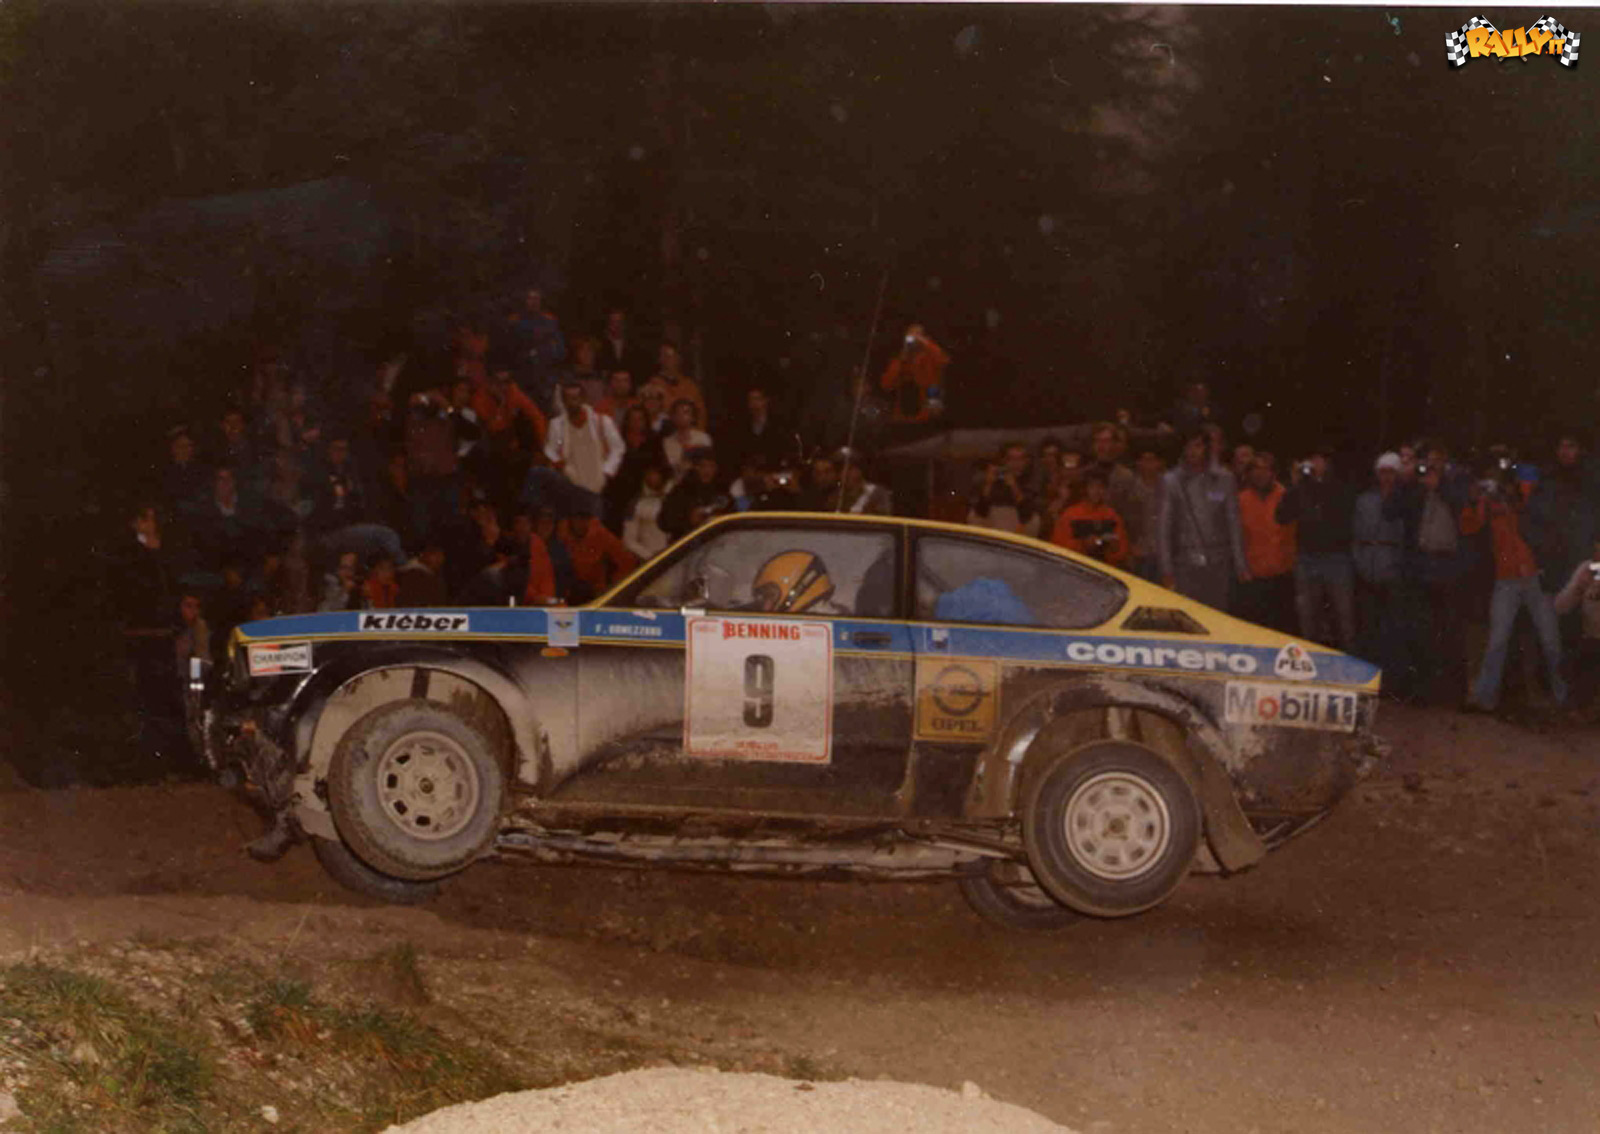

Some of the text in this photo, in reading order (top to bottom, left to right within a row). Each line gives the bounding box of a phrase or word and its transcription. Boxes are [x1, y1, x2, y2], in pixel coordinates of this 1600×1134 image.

[723, 620, 800, 640] BENNING
[1066, 641, 1257, 674] conrero
[742, 654, 775, 728] 9
[1227, 686, 1320, 721] Mobil
